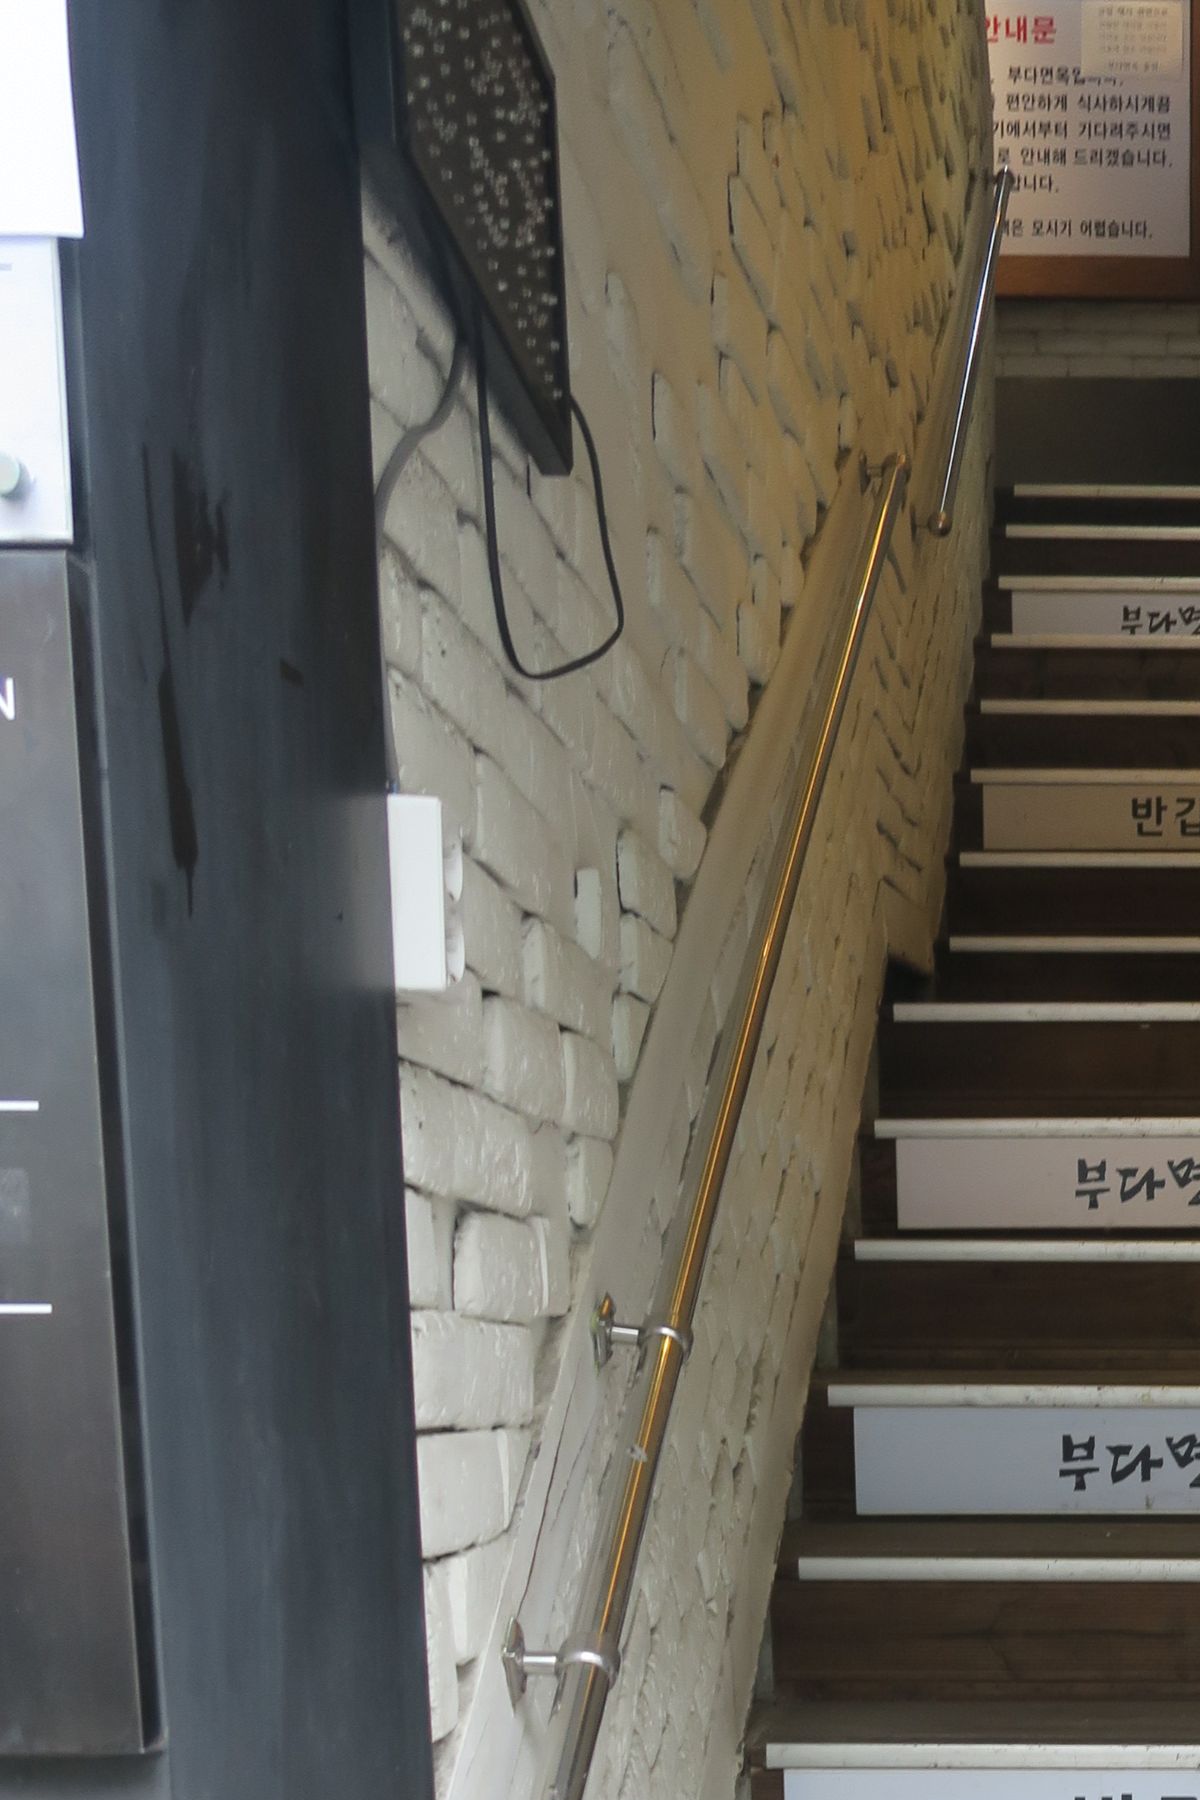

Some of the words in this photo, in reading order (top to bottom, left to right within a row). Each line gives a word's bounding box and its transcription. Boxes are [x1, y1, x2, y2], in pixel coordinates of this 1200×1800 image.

[1007, 93, 1067, 113] 편안하게
[1078, 120, 1171, 140] 기다려주시면
[1020, 147, 1066, 166] 안내해
